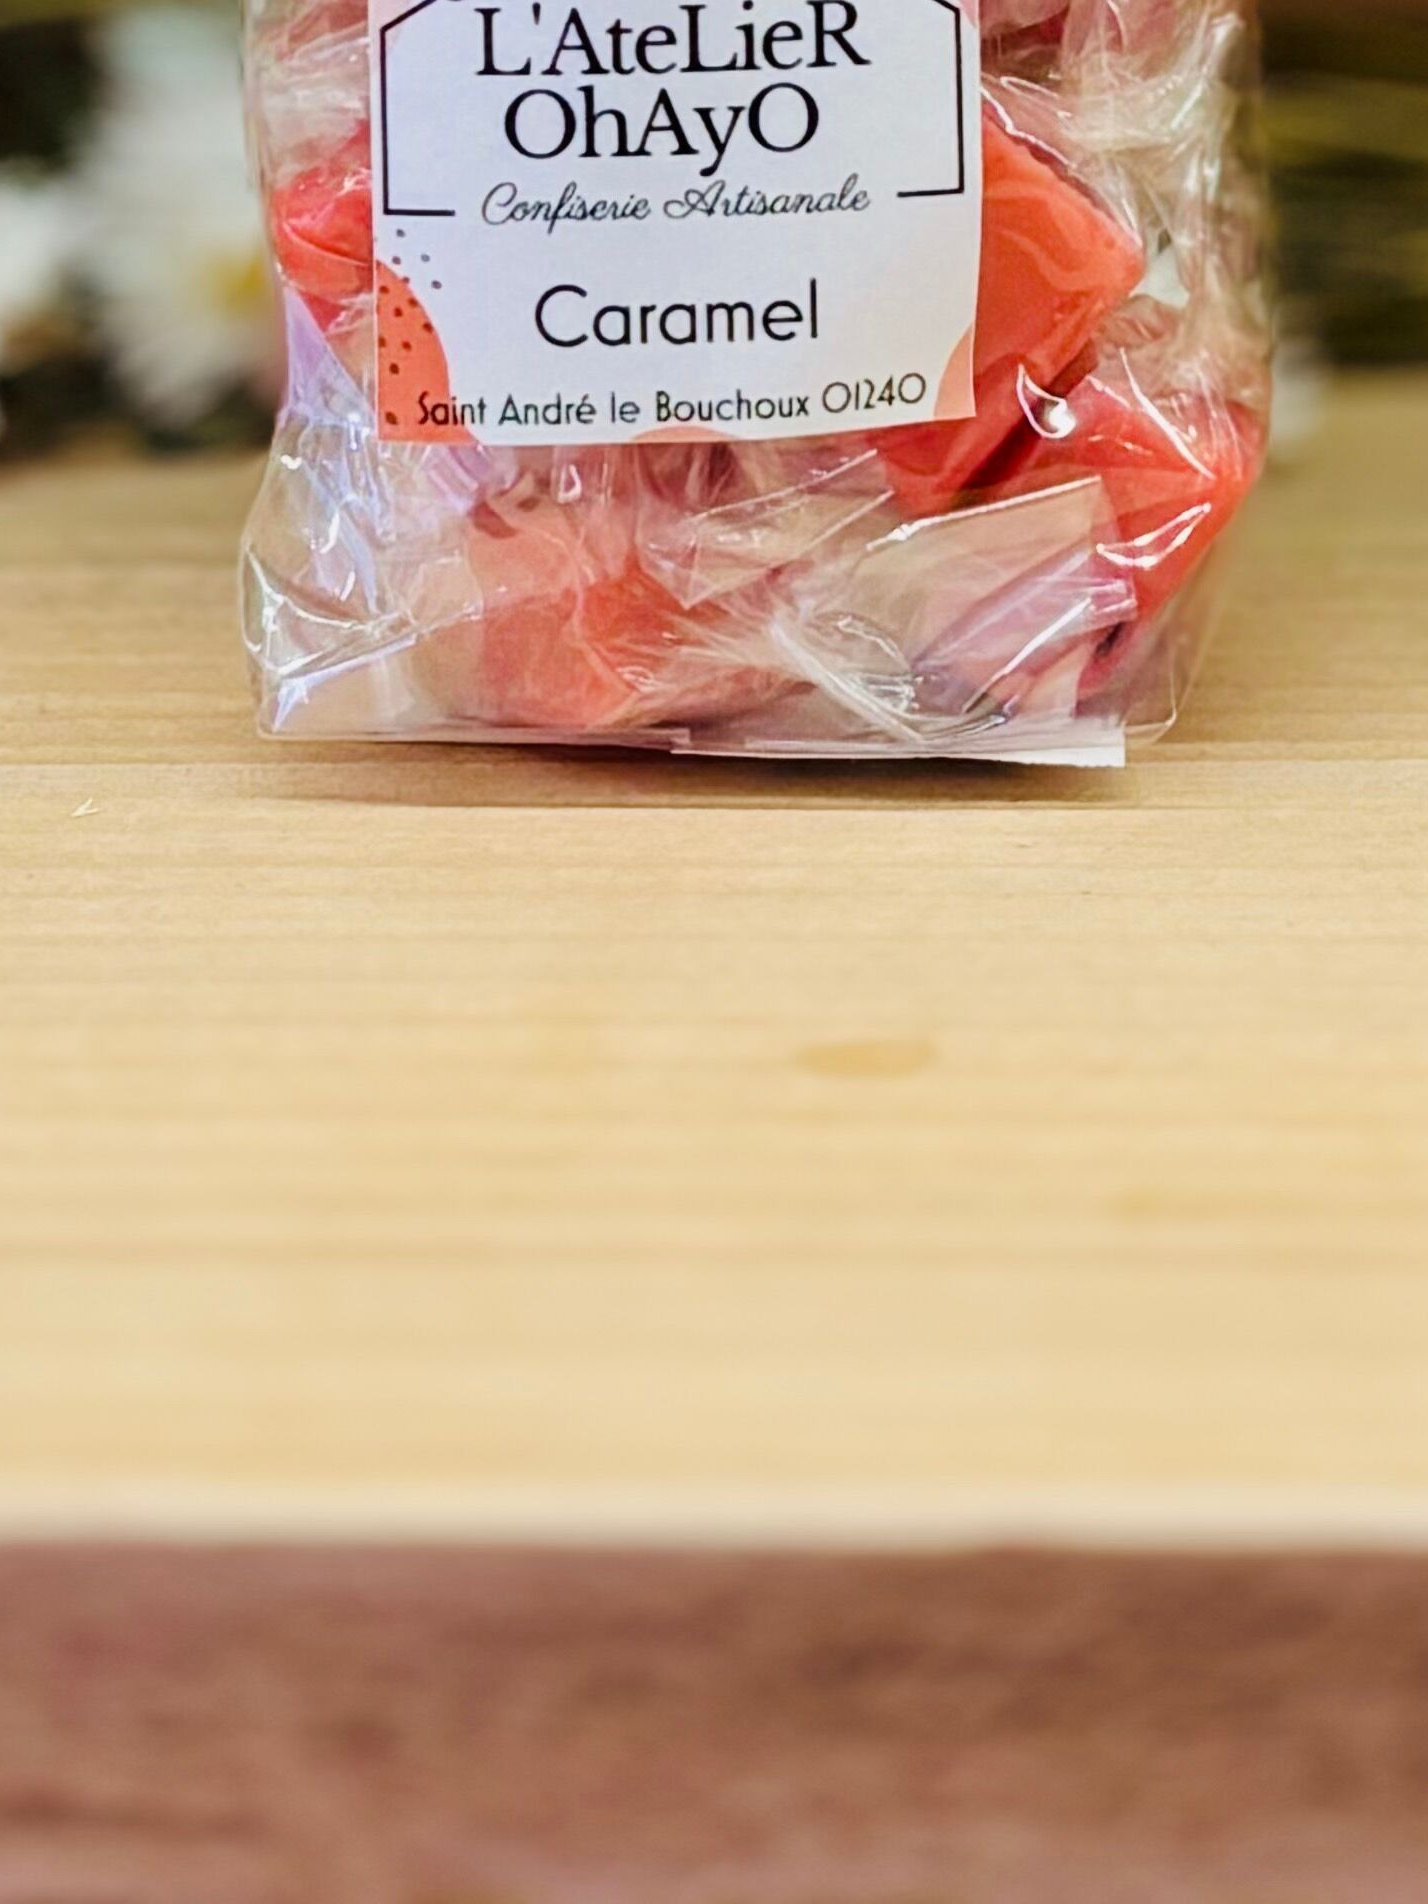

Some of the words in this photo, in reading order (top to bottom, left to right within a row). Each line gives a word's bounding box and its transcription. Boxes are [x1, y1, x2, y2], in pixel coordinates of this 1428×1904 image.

[474, 0, 870, 77] L'AteLieR
[504, 83, 819, 177] OhAyO
[482, 183, 651, 233] Confiserie
[664, 174, 870, 220] Artisanale
[535, 277, 819, 348] Caramel
[417, 393, 487, 426] Saint
[498, 395, 596, 425] André
[610, 395, 641, 422] le
[655, 383, 809, 422] Bouchoux
